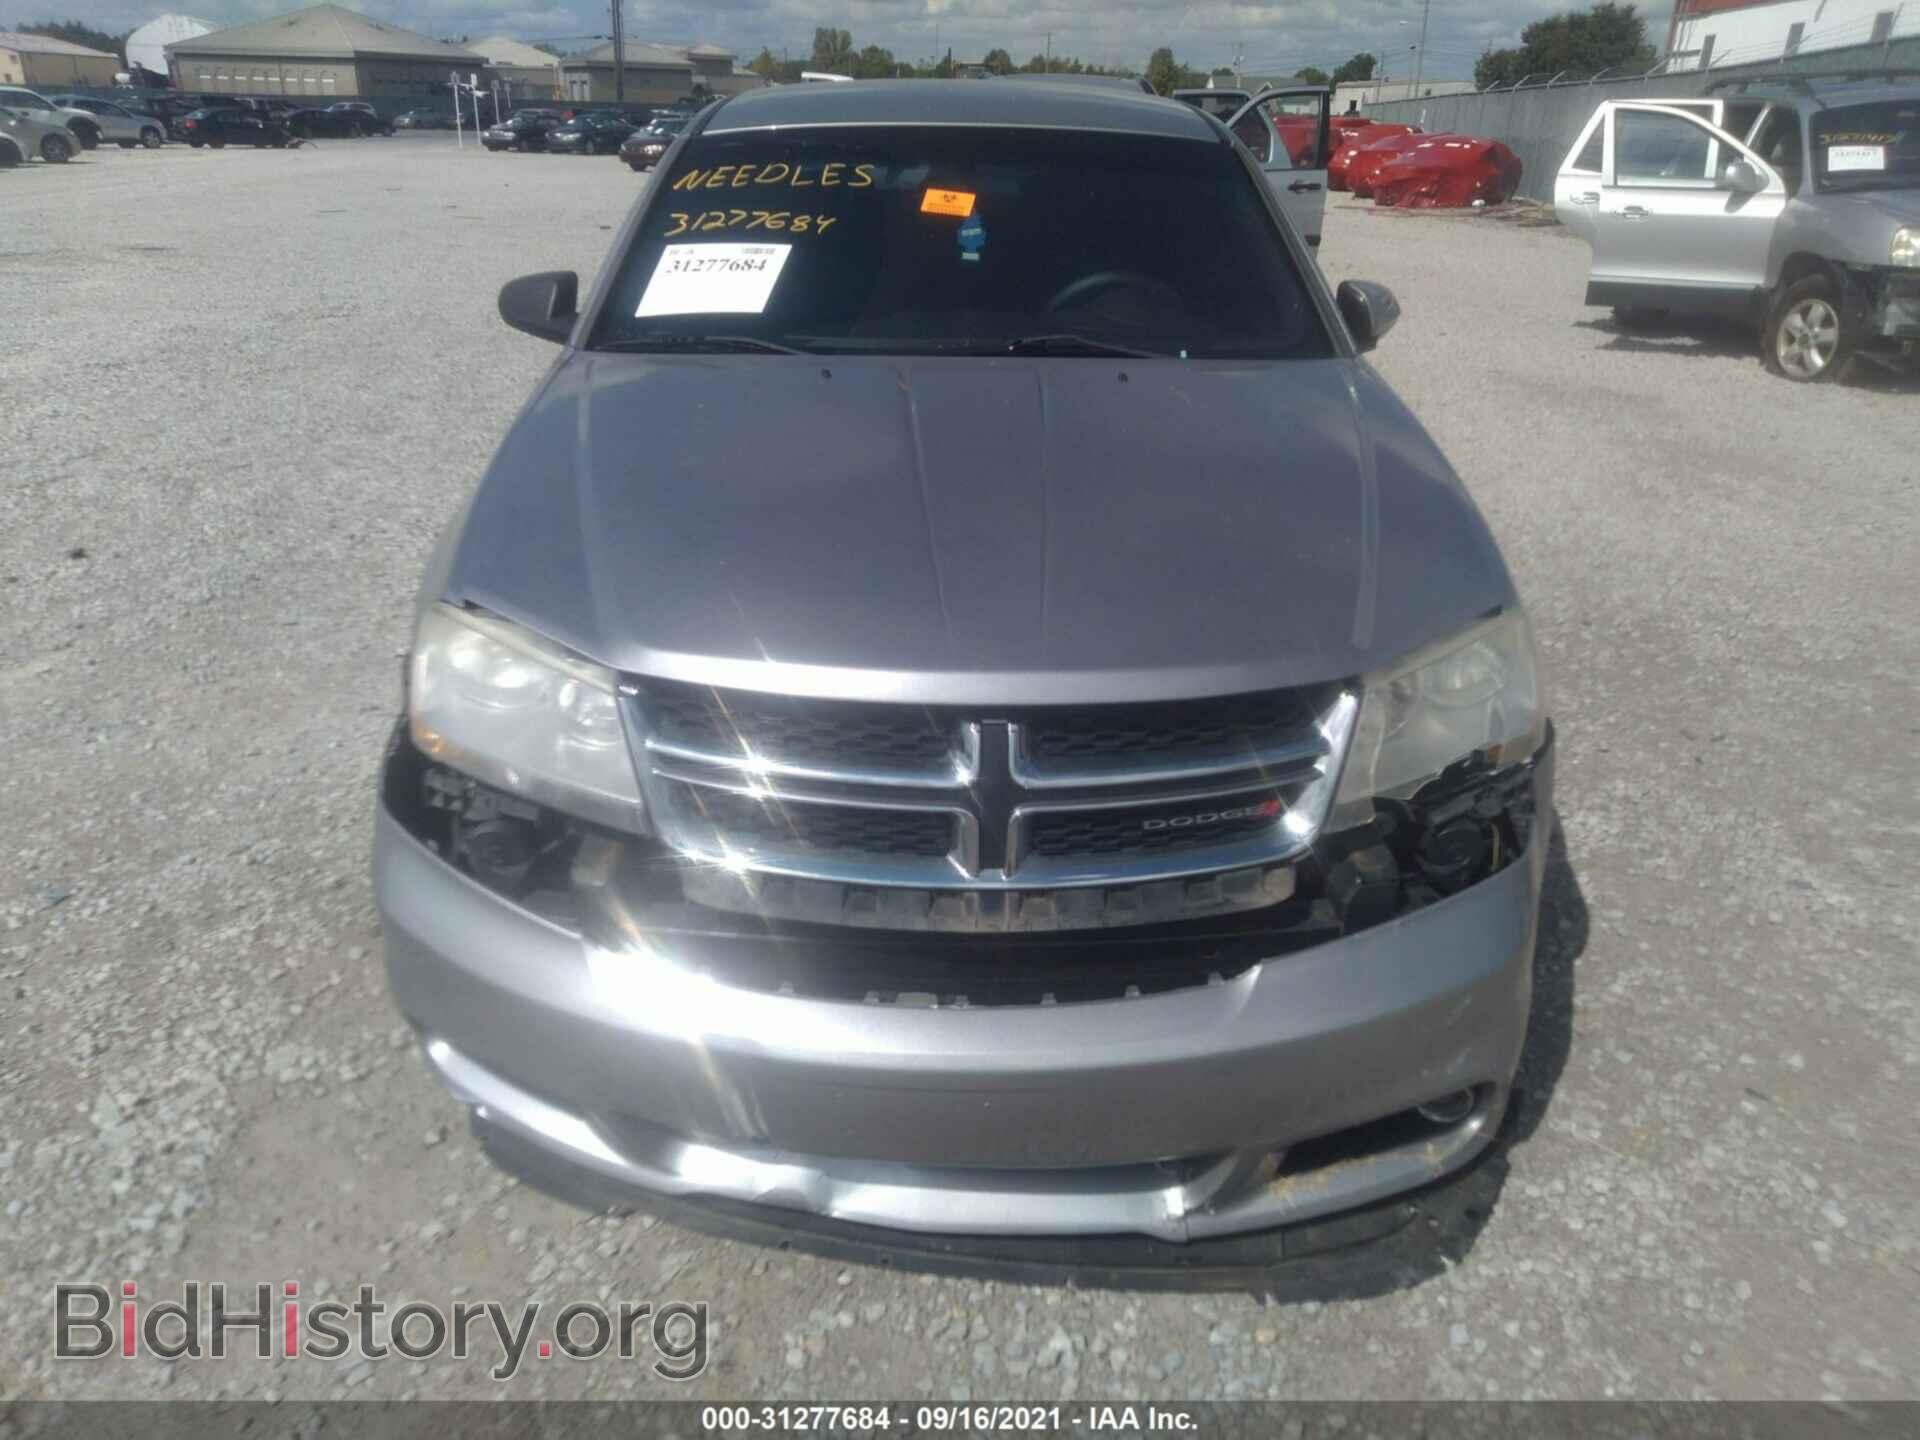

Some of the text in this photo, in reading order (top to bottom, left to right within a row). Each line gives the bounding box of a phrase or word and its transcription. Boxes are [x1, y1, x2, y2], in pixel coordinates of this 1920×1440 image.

[672, 162, 875, 191] NEEDLES
[663, 208, 837, 237] 31277684
[666, 257, 768, 274] 31277684
[1142, 805, 1266, 830] DODGE
